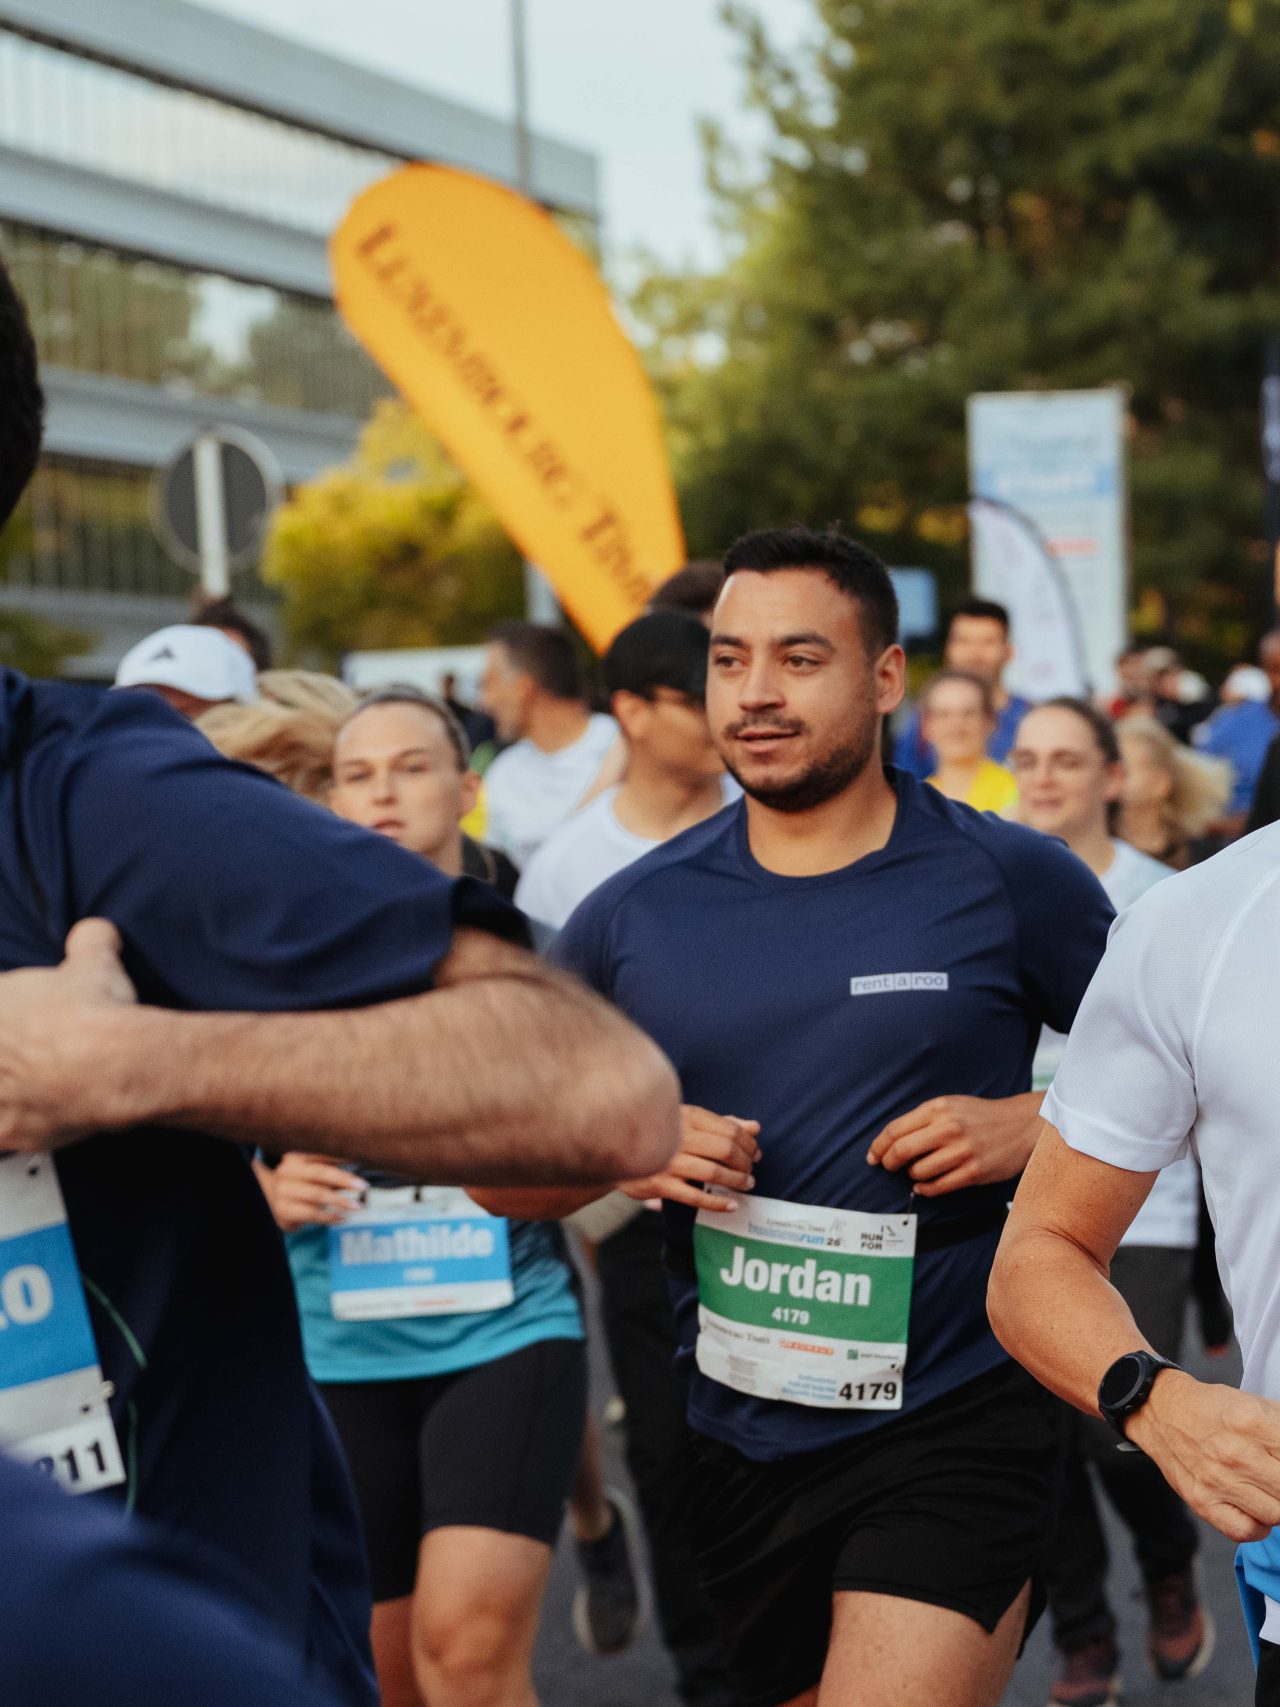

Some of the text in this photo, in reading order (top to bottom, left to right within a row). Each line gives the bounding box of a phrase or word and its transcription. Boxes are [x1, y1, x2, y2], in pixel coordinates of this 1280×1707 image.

[341, 1223, 494, 1265] Mathilde
[826, 1237, 841, 1246] 26
[861, 1232, 883, 1241] RUN
[861, 1242, 883, 1250] FOR
[720, 1246, 871, 1306] Jordan
[771, 1306, 810, 1325] 4179
[839, 1381, 898, 1401] 4179
